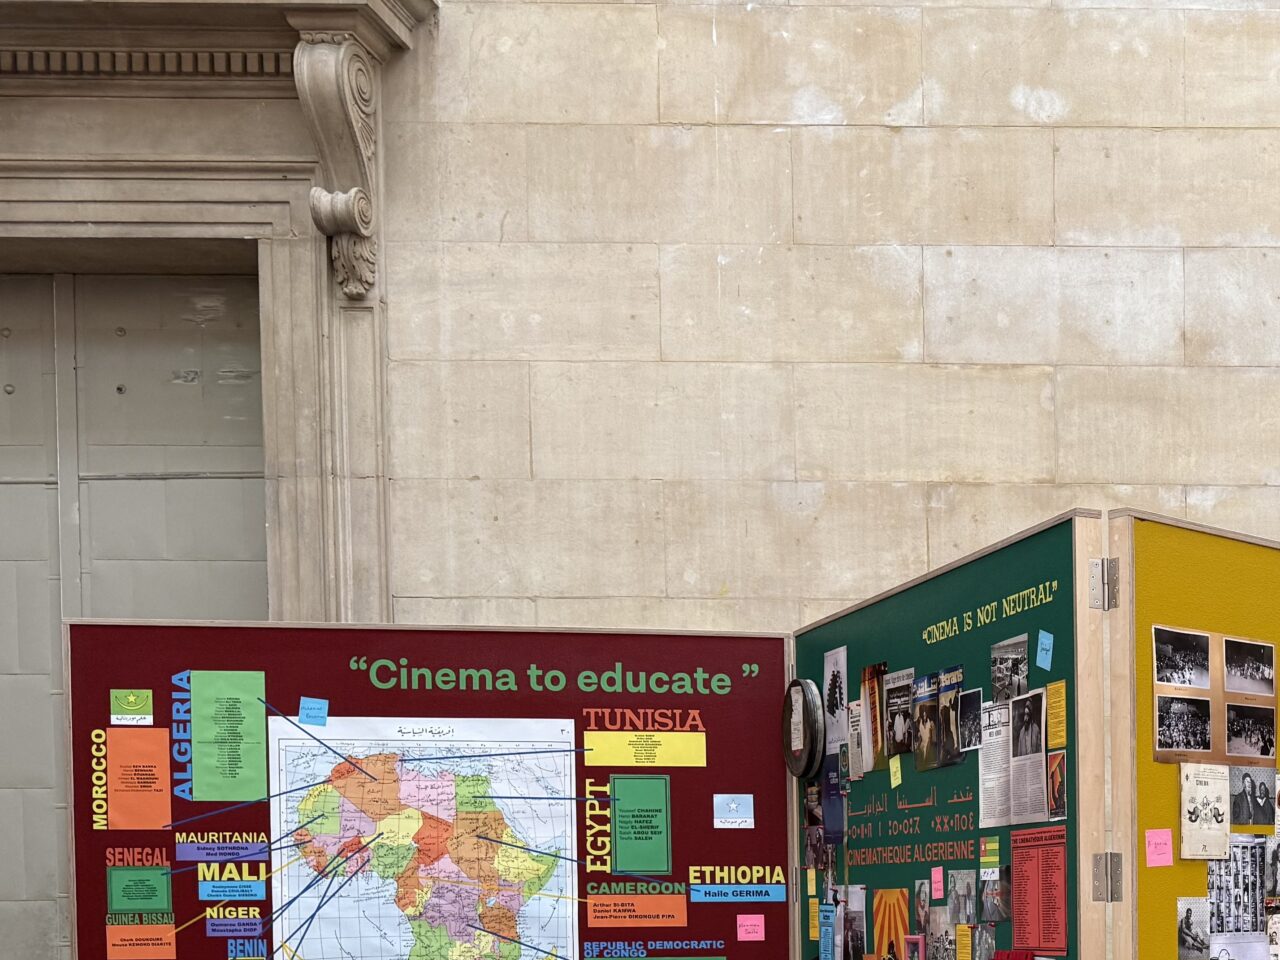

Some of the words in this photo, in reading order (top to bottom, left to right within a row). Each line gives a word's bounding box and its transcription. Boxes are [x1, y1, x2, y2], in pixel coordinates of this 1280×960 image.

[963, 611, 973, 632] IS
[977, 602, 998, 627] NOT
[1002, 580, 1058, 618] NEUTRAL”
[349, 656, 517, 691] “Cinema
[527, 662, 567, 692] to
[577, 662, 732, 695] educate
[583, 707, 706, 731] TUNISIA
[172, 669, 193, 801] ALGERIA
[92, 728, 108, 830] MOROCCO
[585, 778, 611, 874] EGYPT
[175, 832, 268, 844] MAURITANIA
[105, 847, 171, 867] SENEGAL
[847, 845, 912, 866] CINEMATHEQUE
[912, 840, 975, 863] ALGERIENNE
[197, 862, 266, 881] MALI
[689, 865, 786, 884] ETHIOPIA
[586, 882, 686, 895] CAMEROON
[704, 889, 729, 898] Haile
[731, 889, 770, 898] GERIMA
[105, 913, 141, 925] GUINEA
[142, 912, 175, 925] BISSAU
[205, 907, 261, 919] NIGER
[227, 939, 267, 957] BENIN
[583, 941, 644, 950] REPUBLIC
[647, 940, 725, 949] DEMOCRATIC
[584, 950, 600, 958] OF
[603, 950, 647, 958] CONGO
